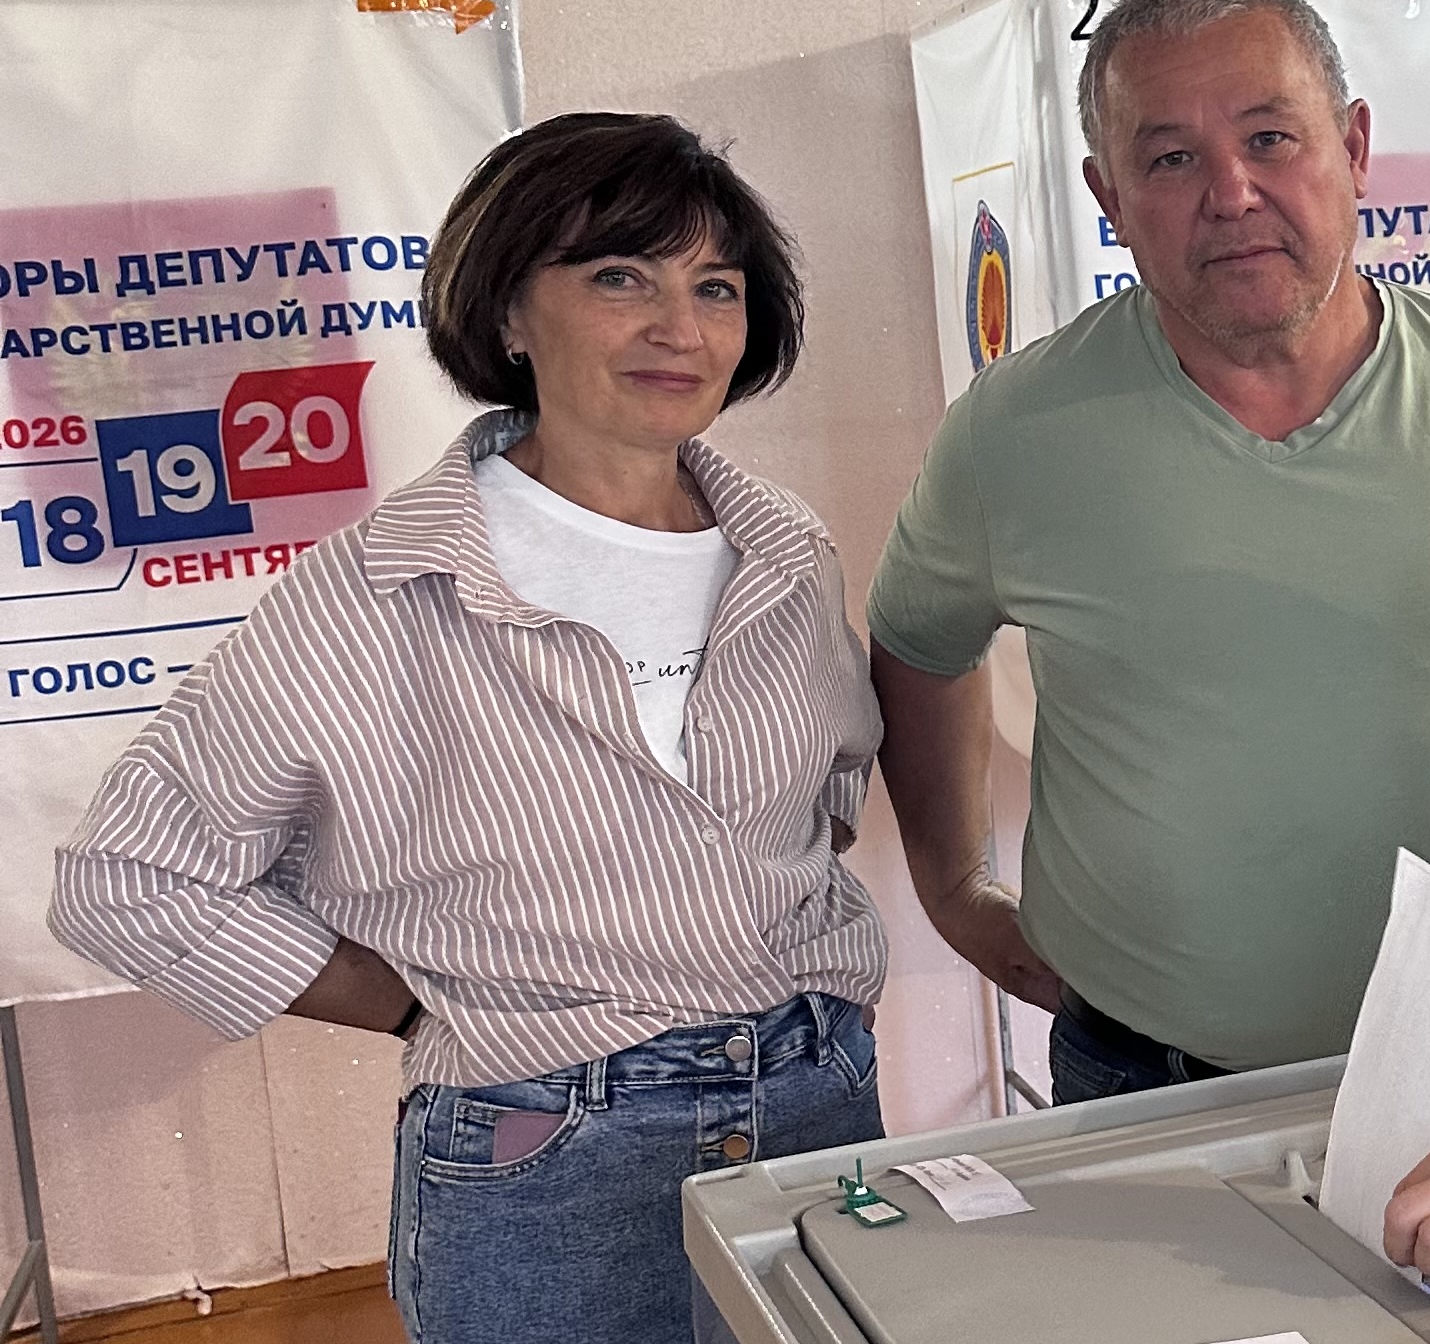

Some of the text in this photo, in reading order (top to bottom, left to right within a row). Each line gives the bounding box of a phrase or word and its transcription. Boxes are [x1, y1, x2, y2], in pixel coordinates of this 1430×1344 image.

[115, 235, 430, 298] ДЕПУТАТОВ
[320, 300, 424, 339] ДУМ
[0, 416, 87, 450] 026
[1, 395, 350, 567] 18 19 20
[143, 541, 317, 588] СЕНТЯ
[8, 656, 156, 697] ГОЛОС
